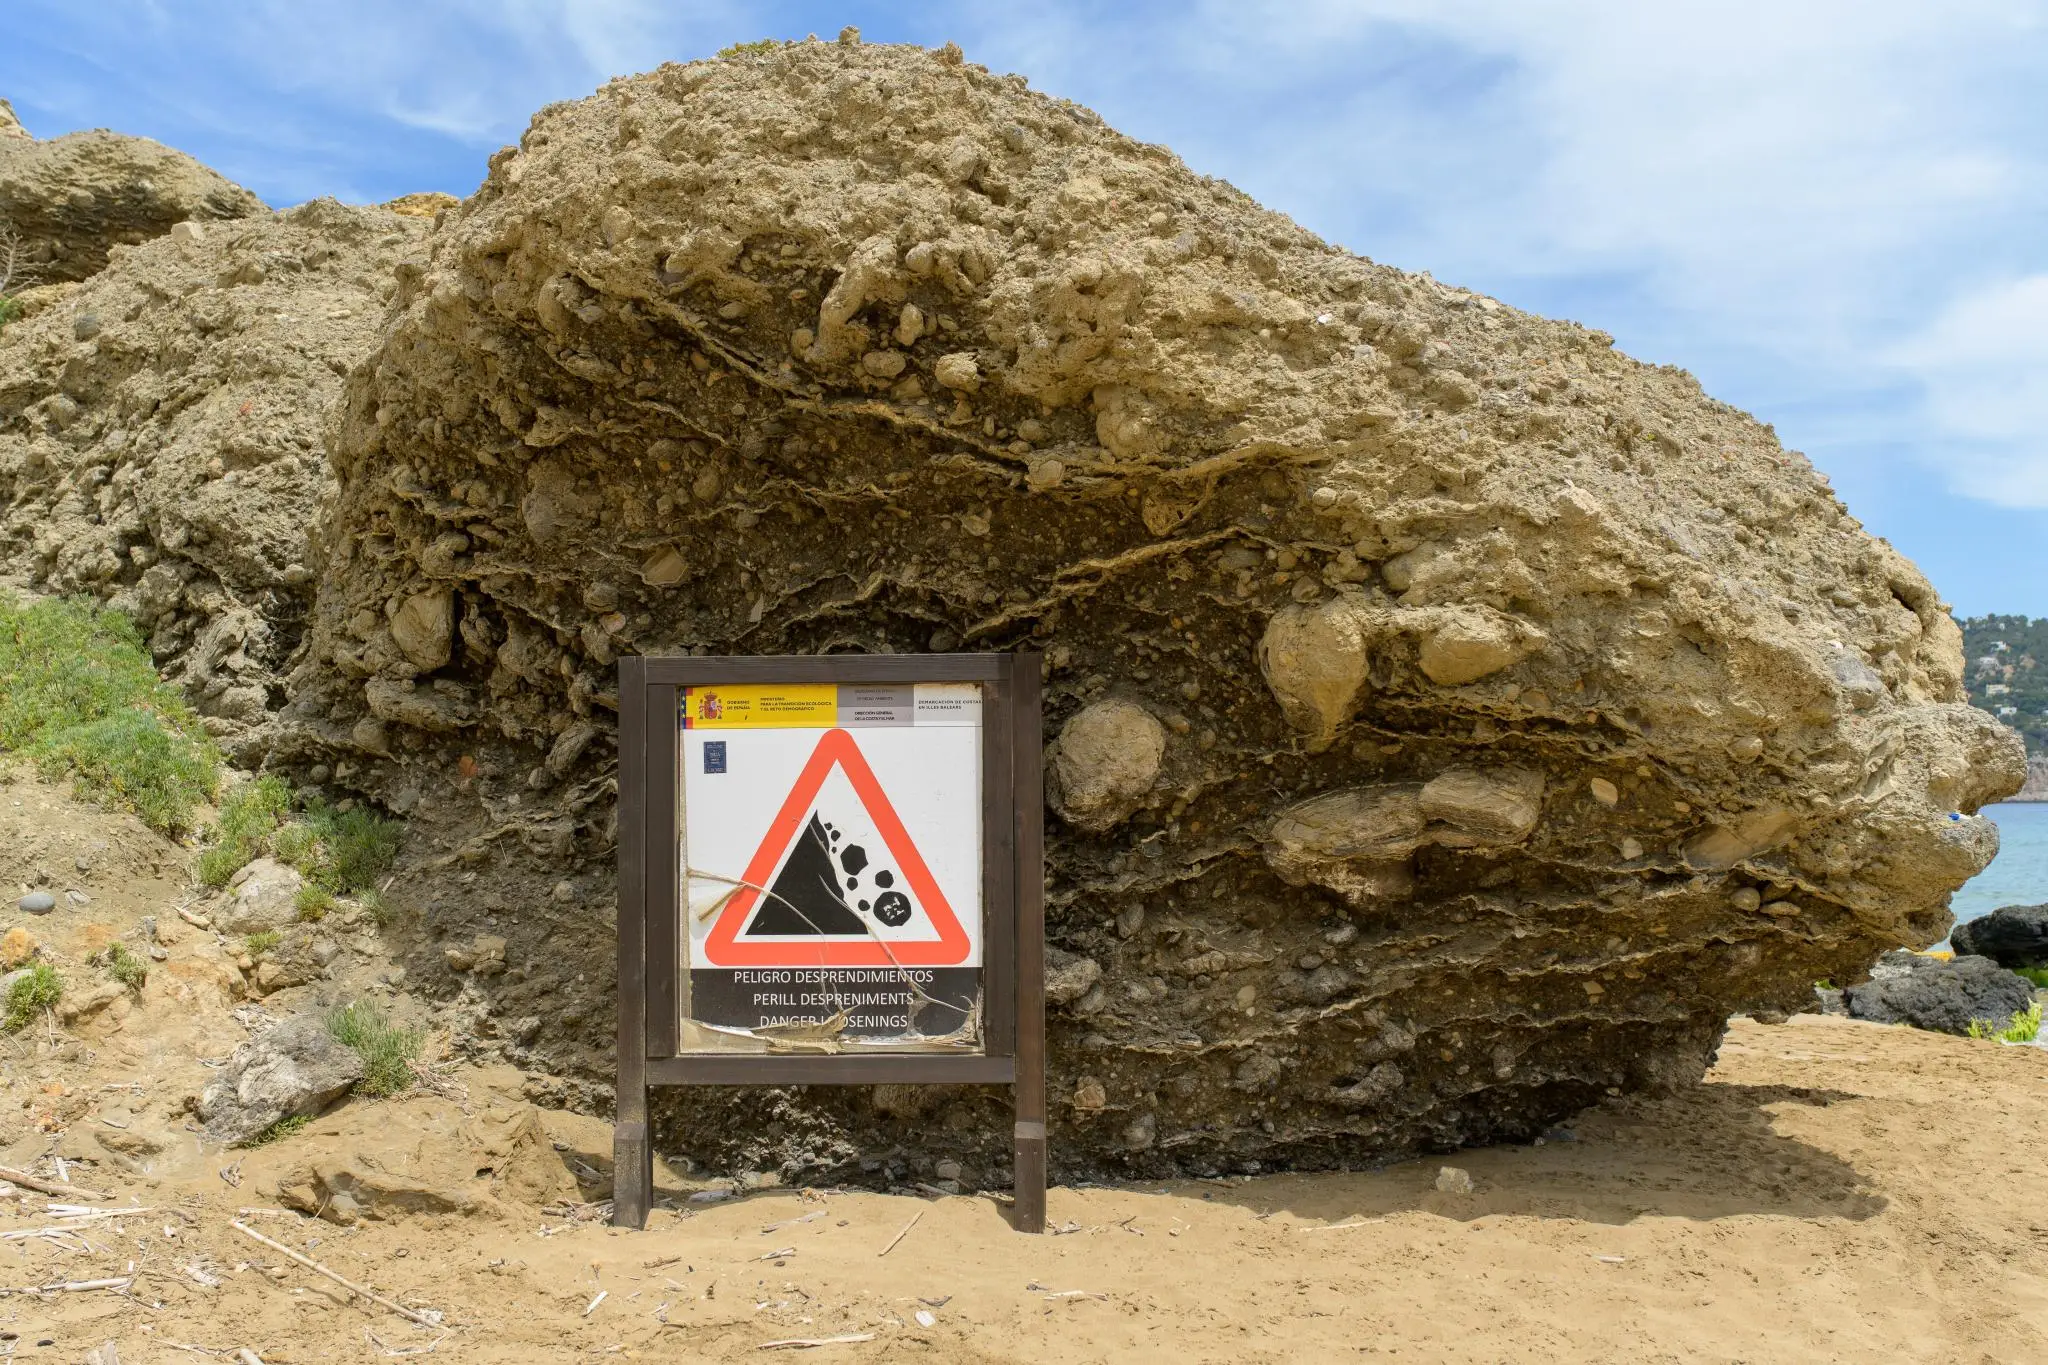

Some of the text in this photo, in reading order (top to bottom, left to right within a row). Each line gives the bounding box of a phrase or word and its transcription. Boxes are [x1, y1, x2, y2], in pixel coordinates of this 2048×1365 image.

[734, 970, 934, 983] PELIGRO DESPRENDIMIENTOS
[753, 992, 914, 1006] PERILL DESPRENIMENTS
